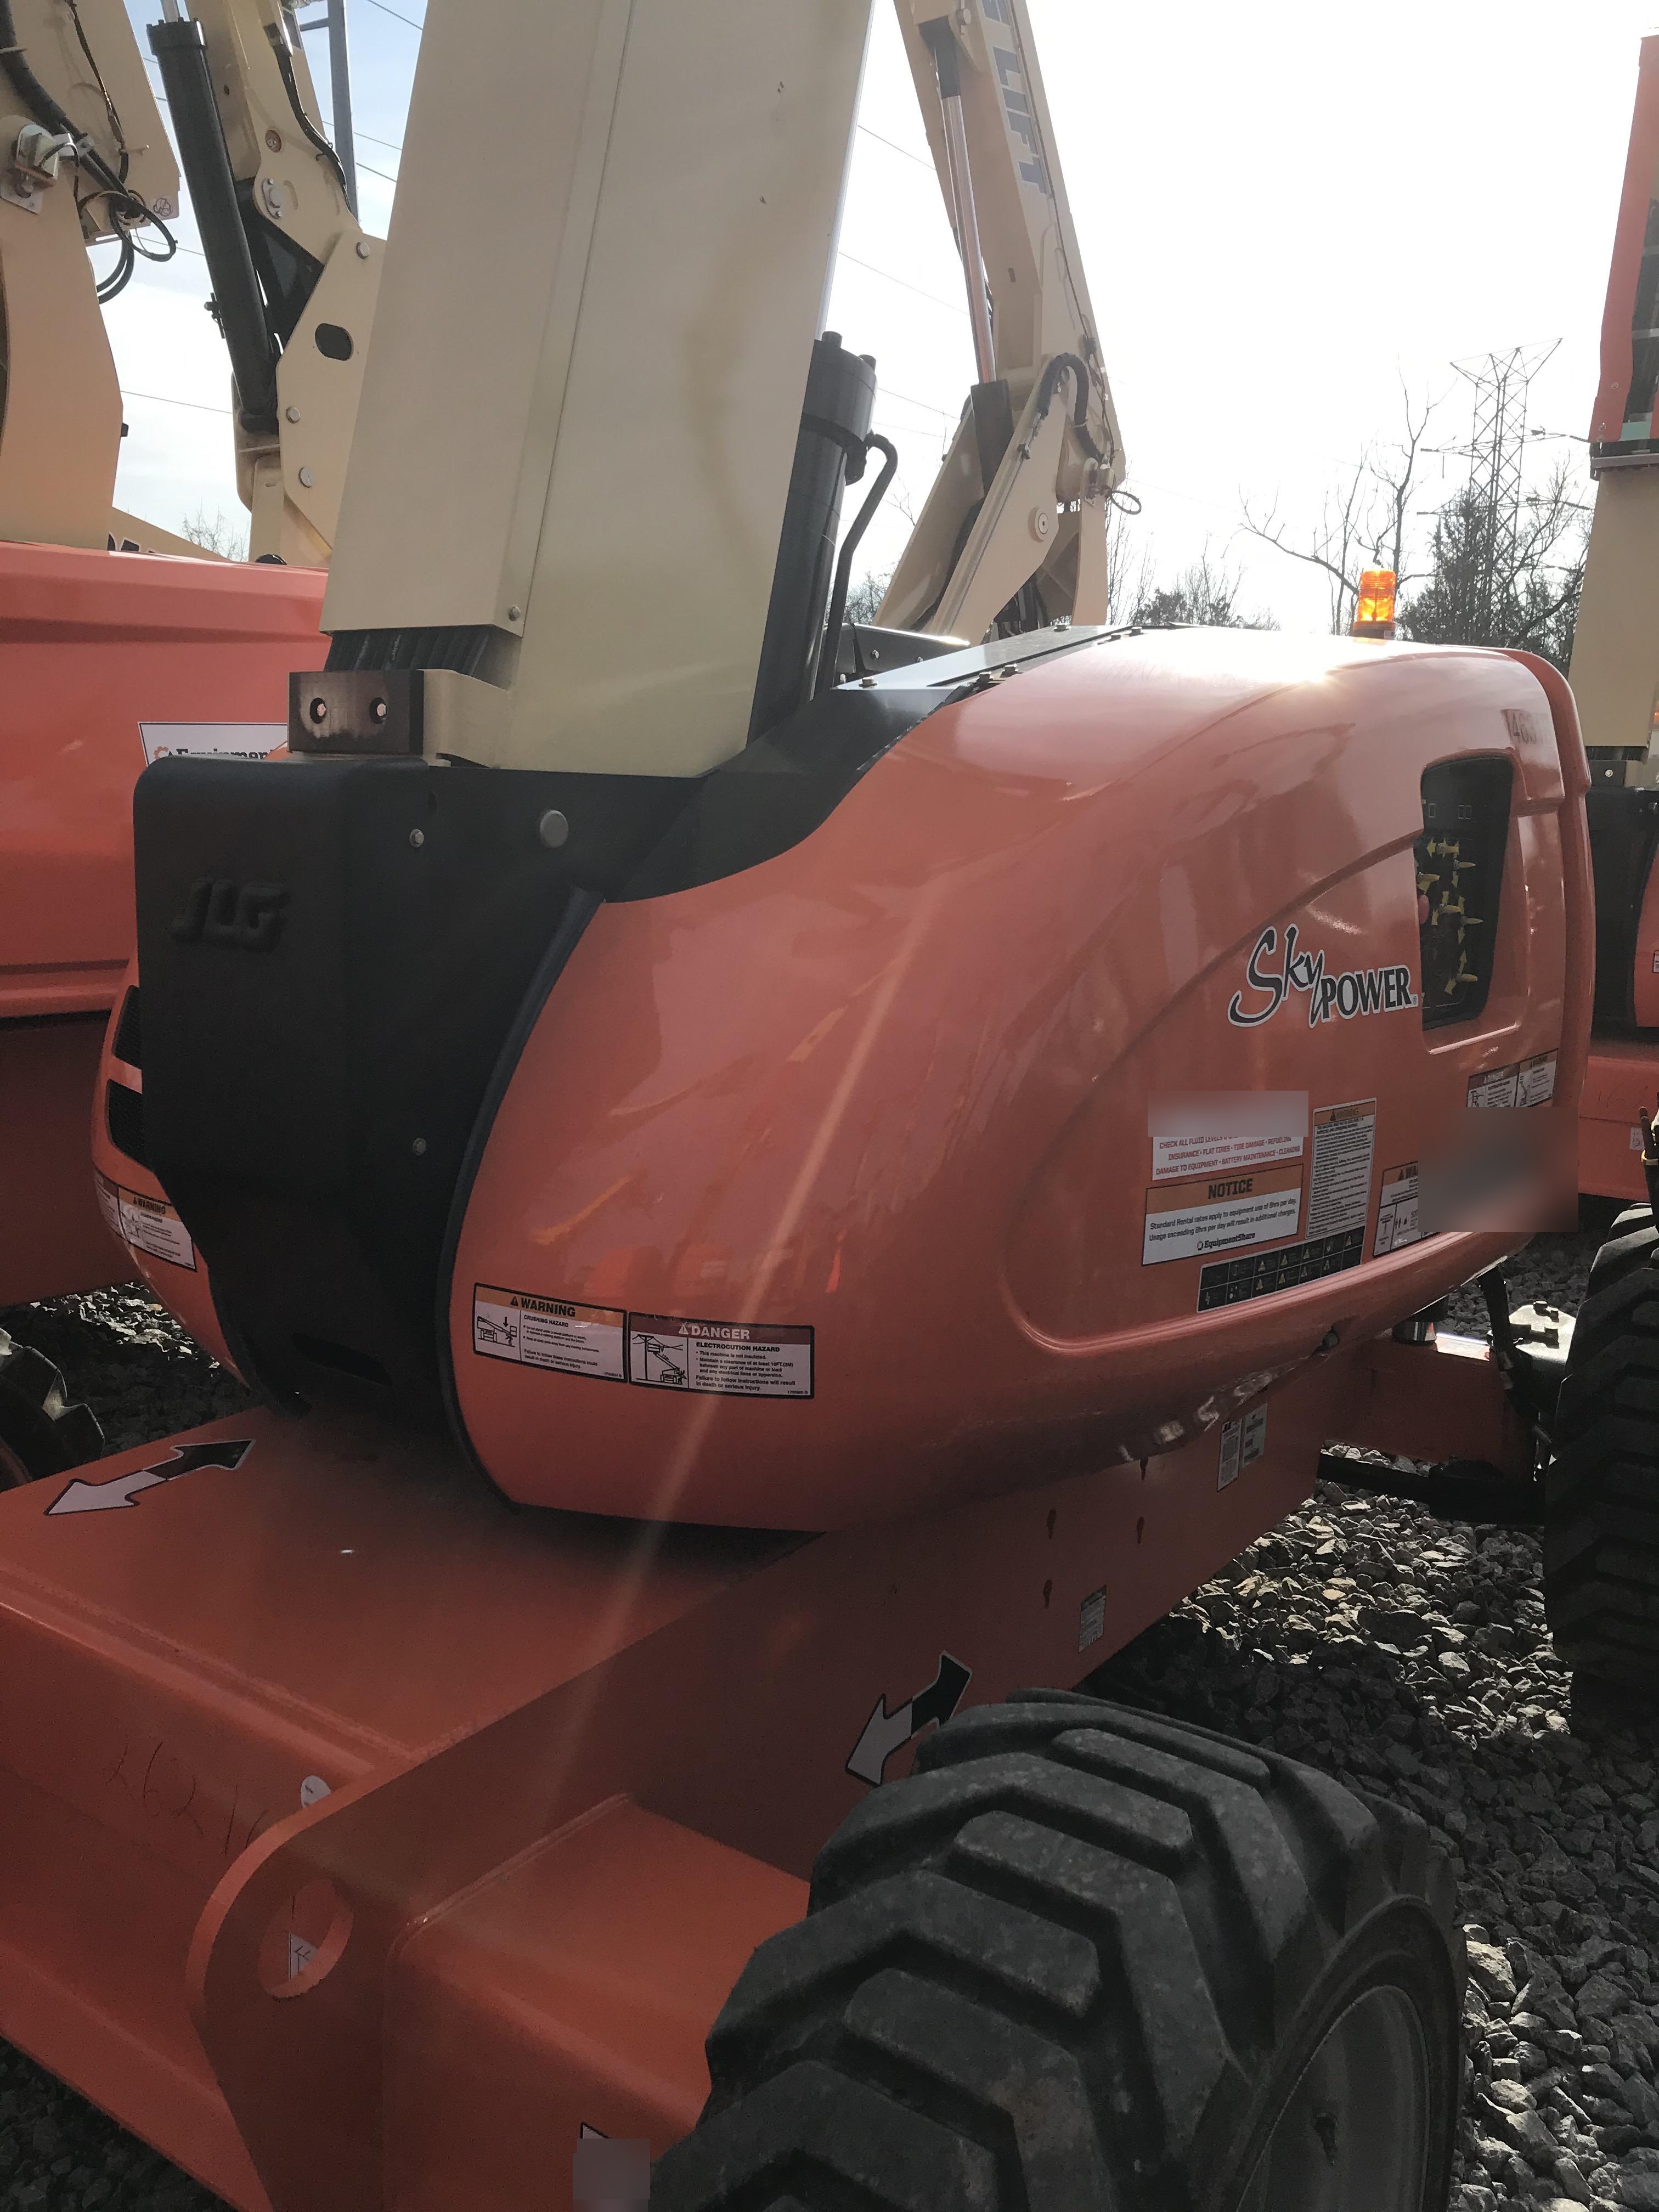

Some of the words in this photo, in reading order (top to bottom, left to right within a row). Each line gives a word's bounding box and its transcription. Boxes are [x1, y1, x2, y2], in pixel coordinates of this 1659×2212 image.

[992, 46, 1047, 195] LIFT
[171, 879, 289, 951] JLG
[1230, 926, 1323, 1025] Sky
[1321, 968, 1411, 1019] POWER
[1159, 1139, 1177, 1150] CHECK
[1178, 1138, 1188, 1147] ALL
[1189, 1135, 1204, 1145] FLUID
[1168, 1149, 1199, 1161] INSURANCE
[1203, 1147, 1215, 1155] FLAT
[1216, 1144, 1230, 1153] TIRES
[1245, 1139, 1264, 1148] DAMAGE
[1156, 1165, 1178, 1175] DAMAGE
[1188, 1159, 1218, 1170] EQUIPMENT
[1222, 1155, 1242, 1164] BATTERY
[1243, 1149, 1276, 1161] MAINTENANCE
[1278, 1145, 1300, 1155] CLEANING
[1207, 1177, 1253, 1199] NOTICE
[138, 1200, 166, 1215] WARNING
[1150, 1219, 1175, 1230] Standard
[1176, 1216, 1193, 1226] Rental
[1209, 1212, 1222, 1222] apply
[1229, 1206, 1254, 1217] equipment
[1269, 1200, 1279, 1209] 8hrs
[1149, 1232, 1166, 1243] Usage
[1167, 1227, 1194, 1239] exceeding
[1195, 1224, 1207, 1233] 8hrs
[1217, 1221, 1226, 1230] day
[1235, 1217, 1249, 1226] result
[1255, 1211, 1277, 1222] additional
[1278, 1208, 1296, 1217] charges.
[1204, 1231, 1255, 1249] EquipmentShare
[521, 1297, 575, 1317] WARNING
[523, 1314, 548, 1323] CRUSHING
[549, 1319, 568, 1327] HAZARD
[691, 1324, 749, 1340] DANGER
[696, 1341, 751, 1350] ELECTROCUTION
